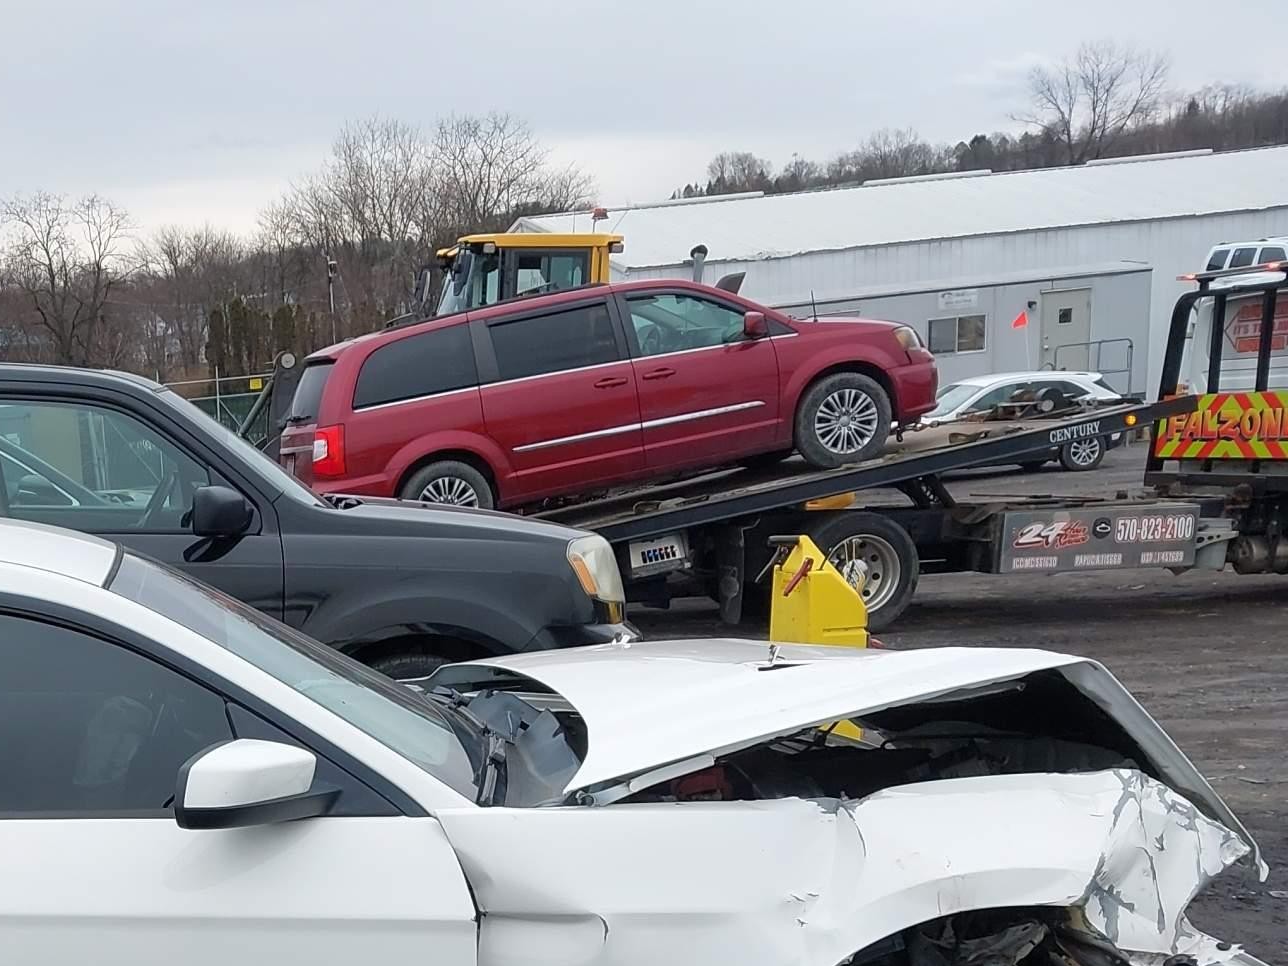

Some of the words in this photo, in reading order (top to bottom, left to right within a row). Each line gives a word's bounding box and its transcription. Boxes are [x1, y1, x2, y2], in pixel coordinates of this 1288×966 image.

[1049, 421, 1100, 443] CENTURY
[1014, 521, 1067, 548] 24
[1116, 515, 1193, 542] 570-823-2100
